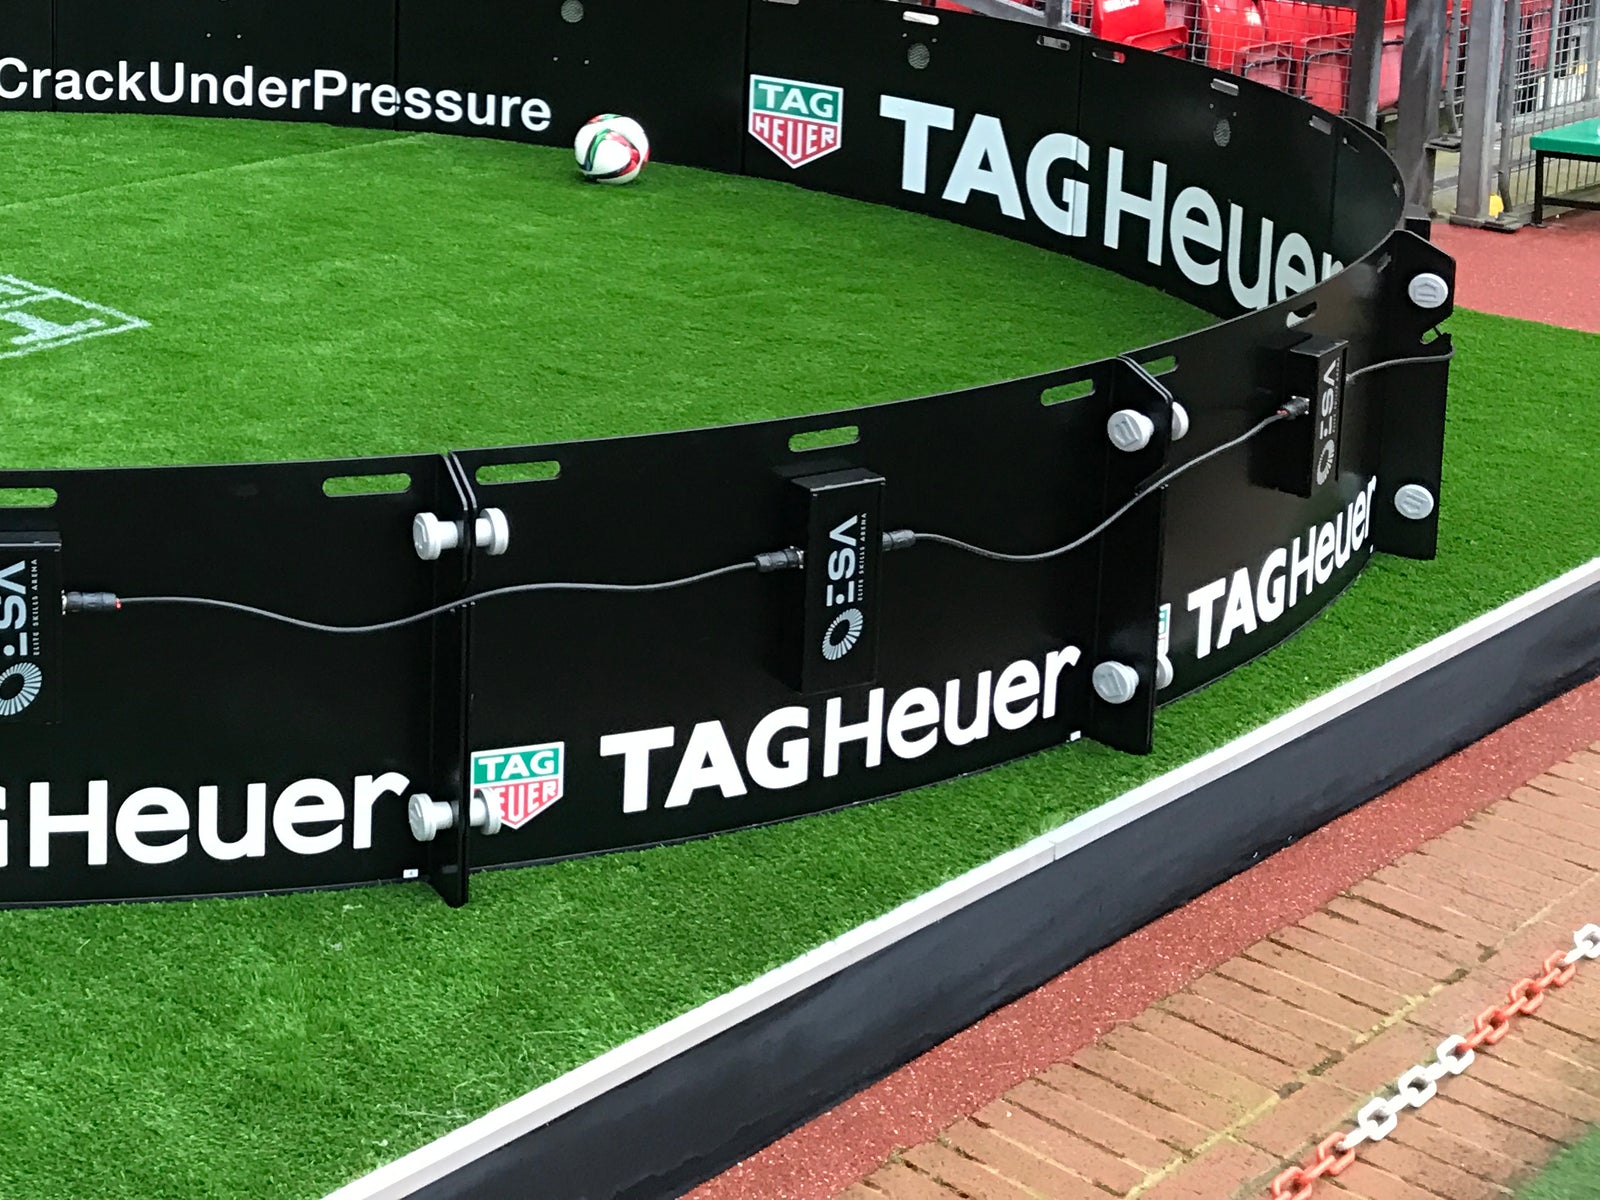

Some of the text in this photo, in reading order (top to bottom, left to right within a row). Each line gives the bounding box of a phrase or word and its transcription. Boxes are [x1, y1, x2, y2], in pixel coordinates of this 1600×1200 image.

[758, 83, 834, 119] TAG
[754, 115, 836, 161] HEUER
[478, 750, 555, 781] TAG
[480, 779, 558, 823] EUER
